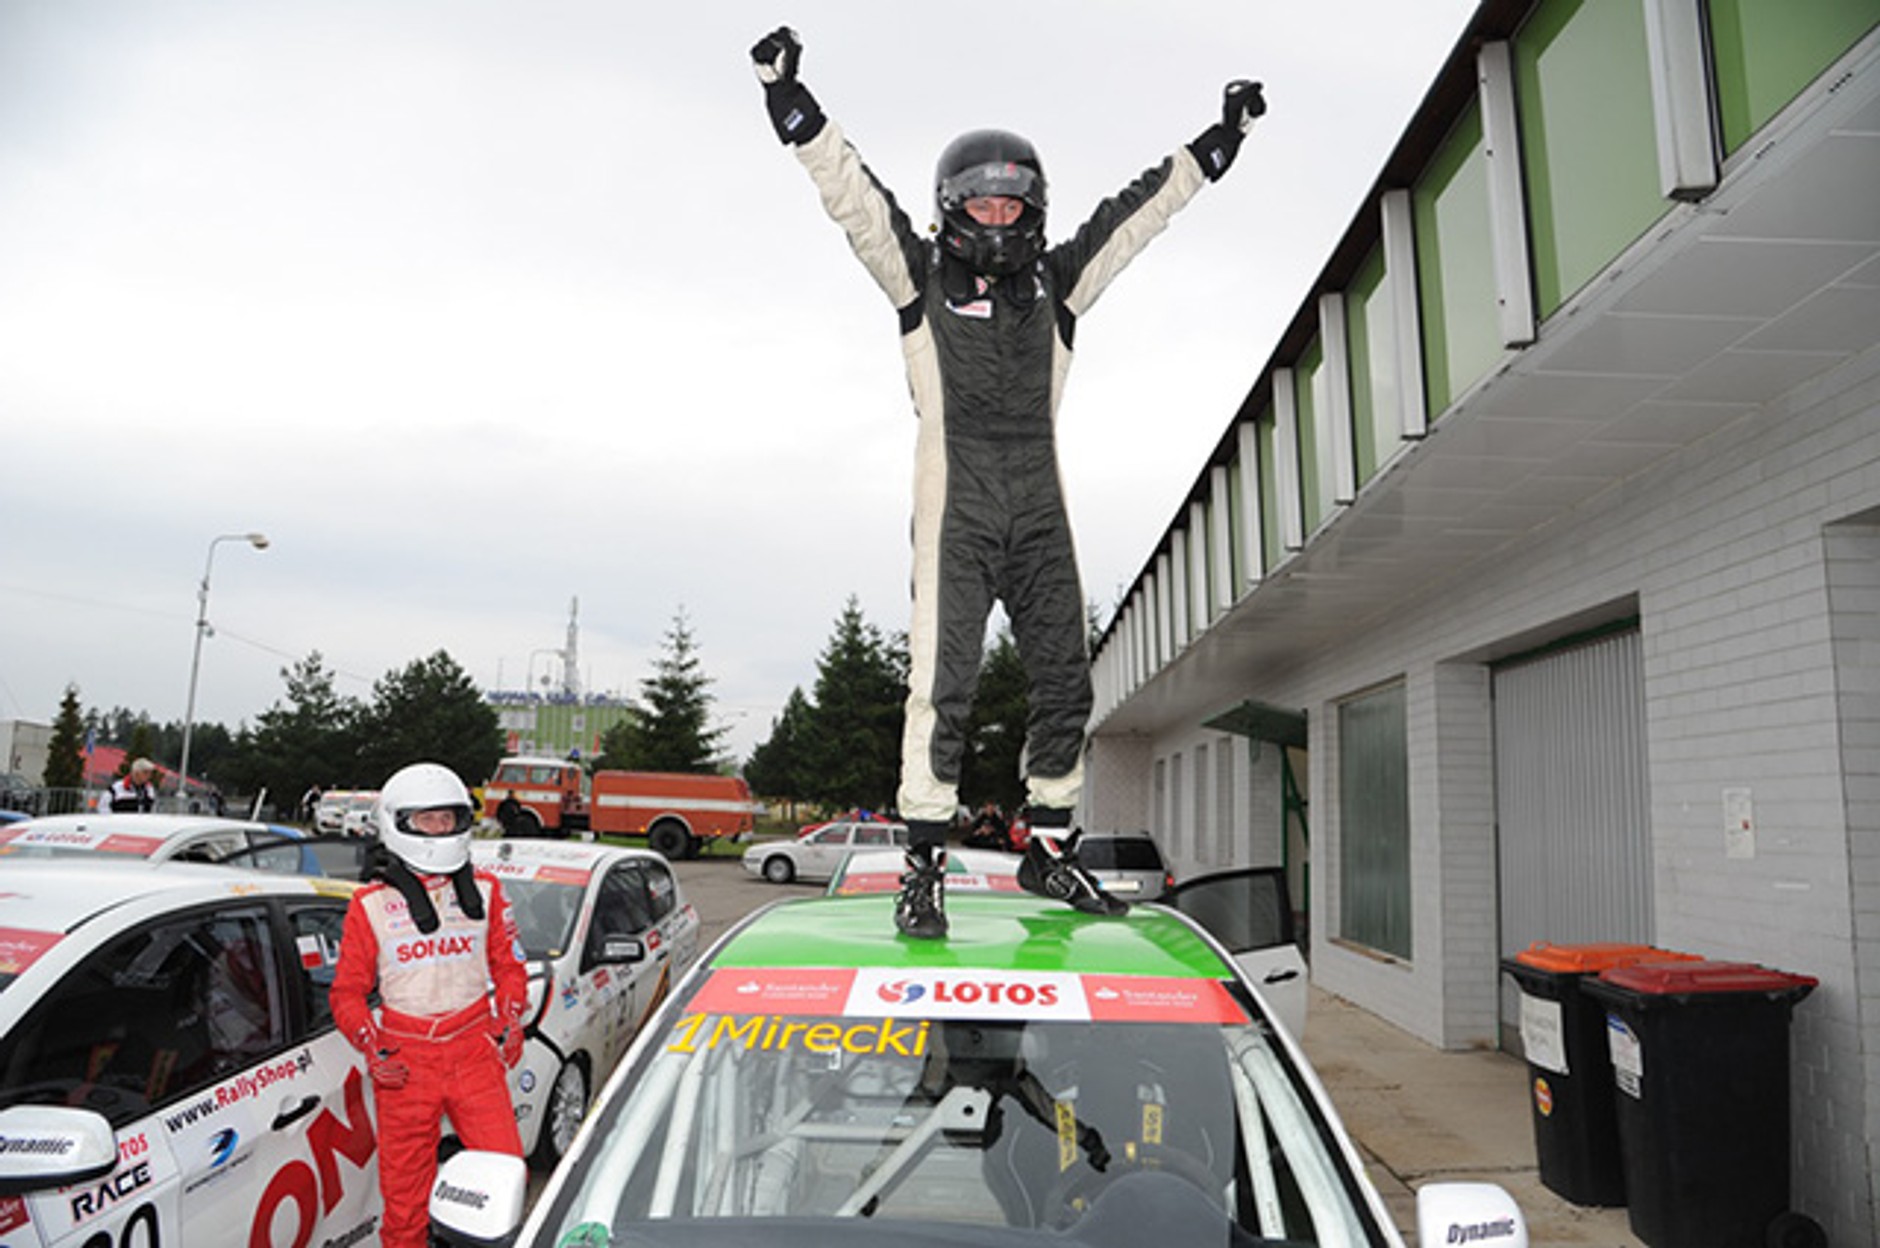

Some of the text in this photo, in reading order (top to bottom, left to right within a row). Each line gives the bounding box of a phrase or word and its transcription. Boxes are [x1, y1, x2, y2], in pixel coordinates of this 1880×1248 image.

[396, 935, 475, 963] SONAX
[933, 980, 1059, 1006] LOTOS
[164, 1048, 314, 1134] www.RallyShop.pl
[119, 1133, 149, 1160] TOS
[70, 1160, 151, 1221] RACE
[1447, 1218, 1515, 1246] Dynamic
